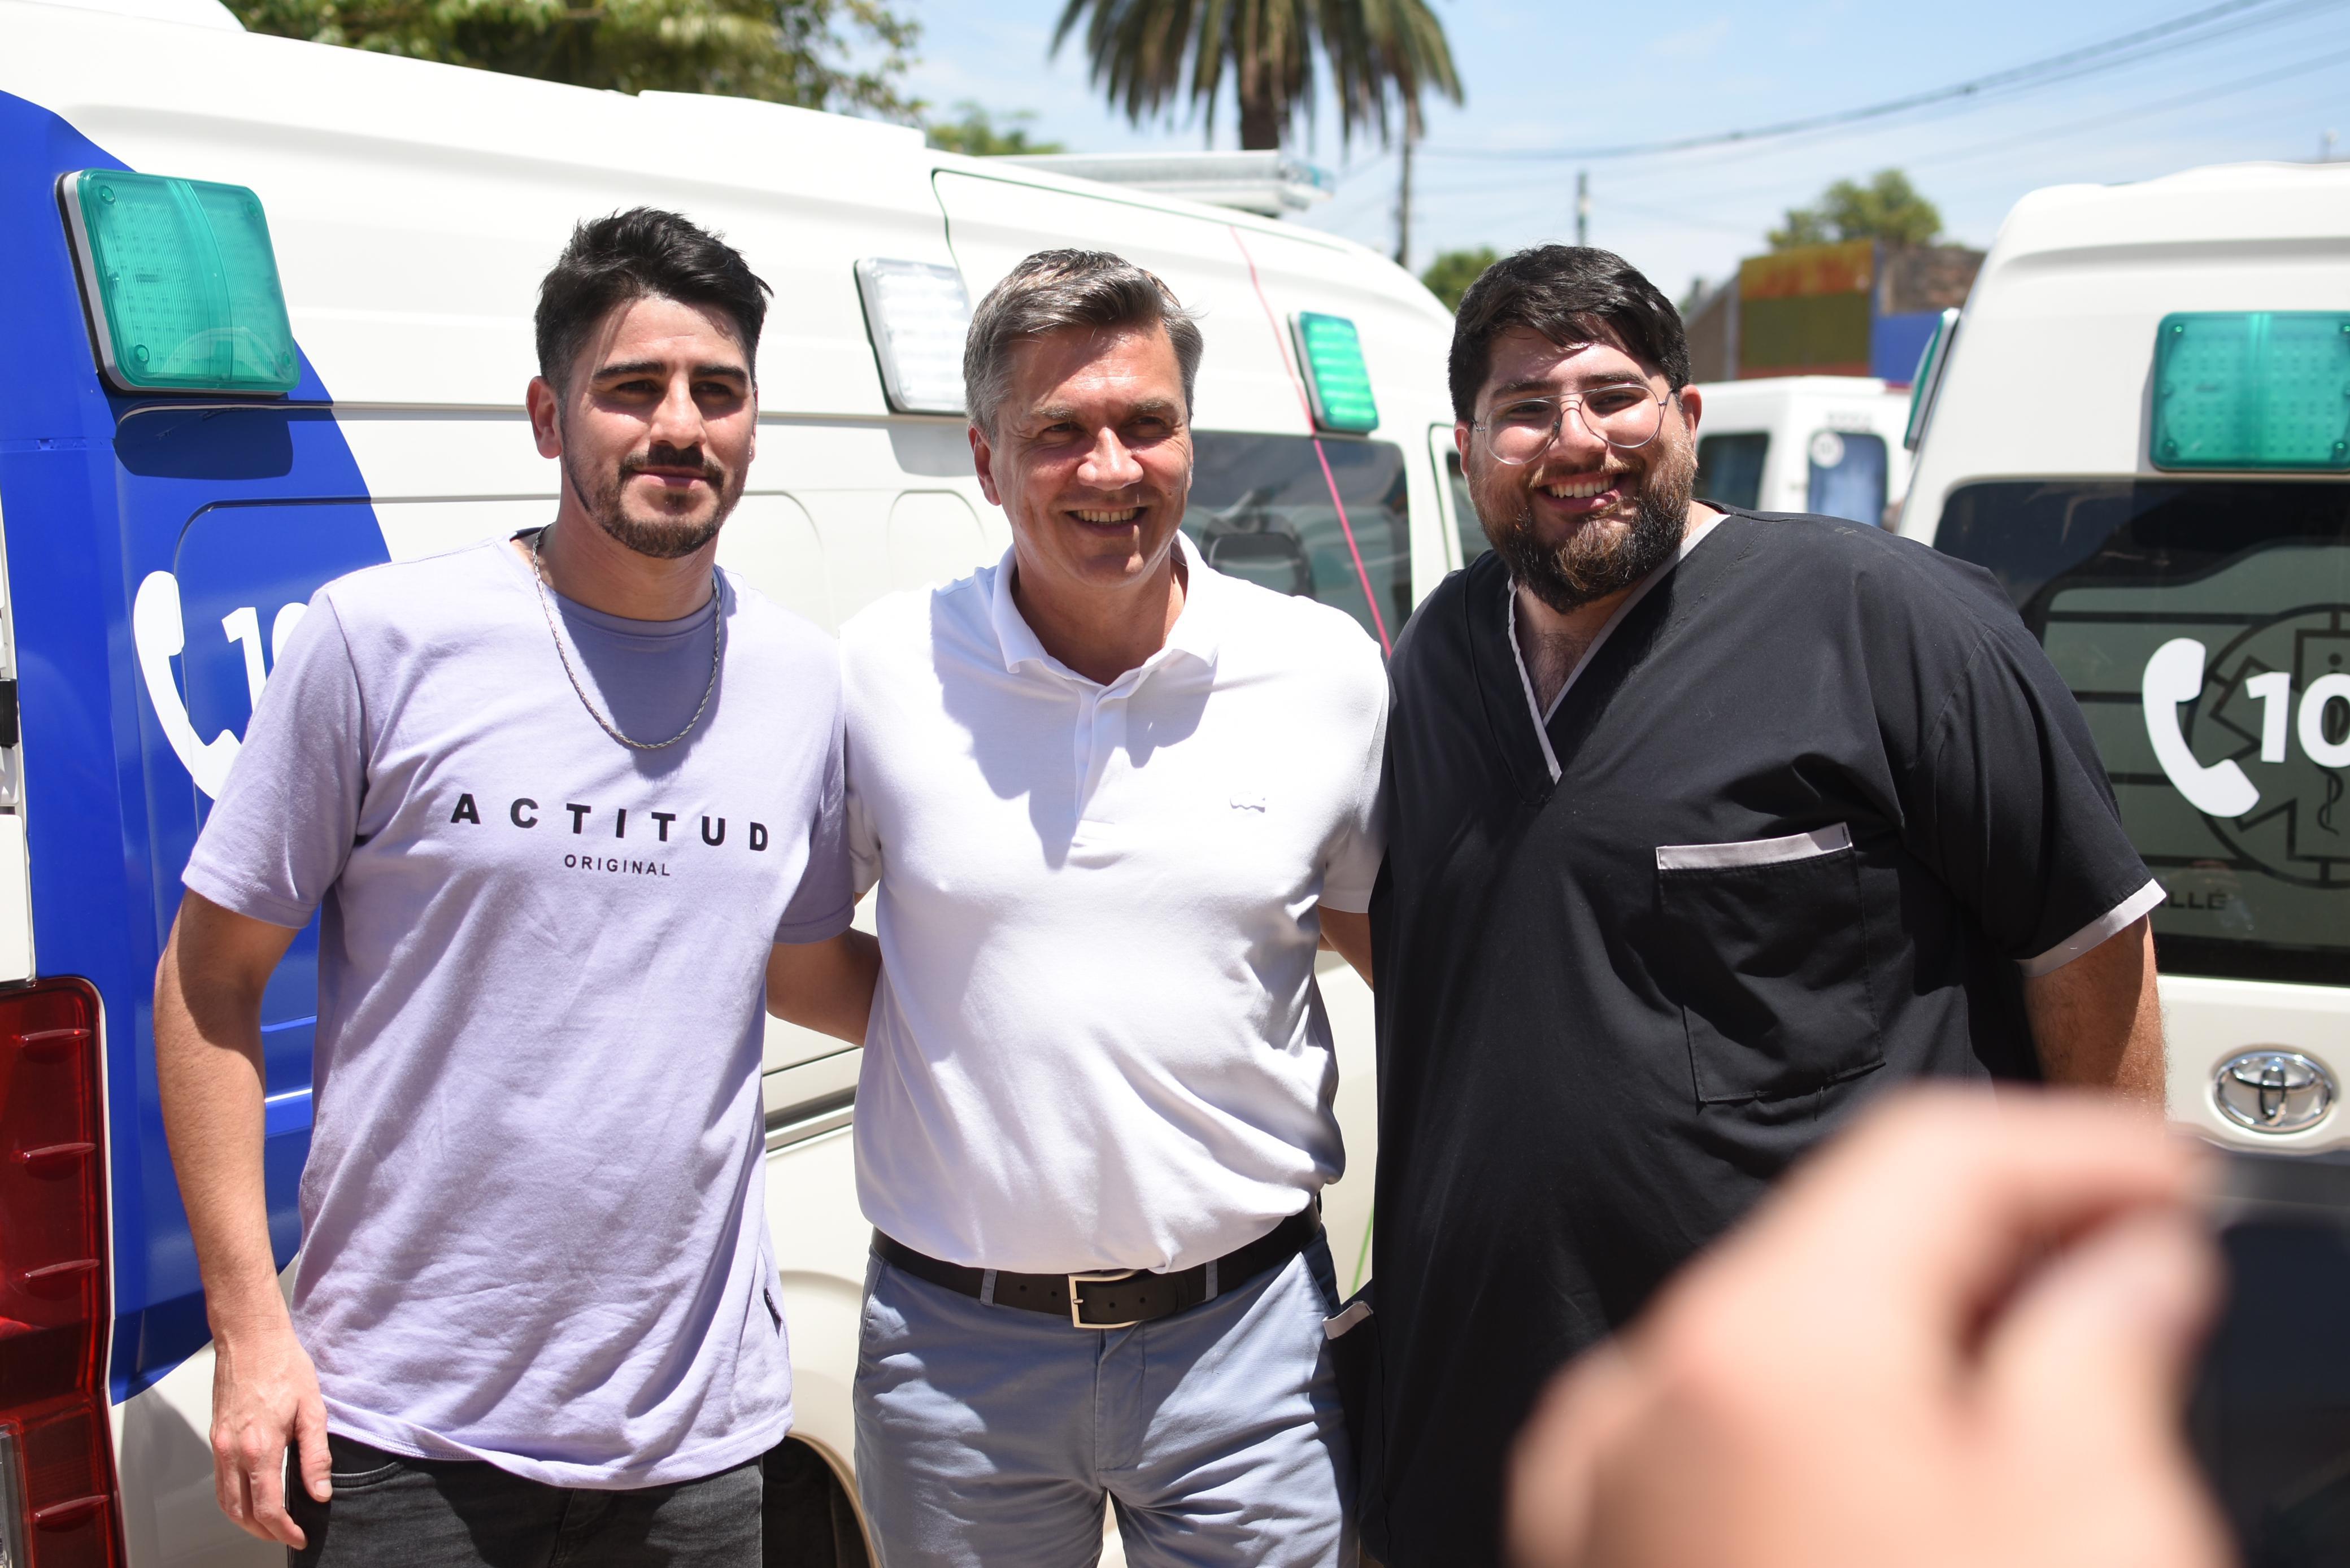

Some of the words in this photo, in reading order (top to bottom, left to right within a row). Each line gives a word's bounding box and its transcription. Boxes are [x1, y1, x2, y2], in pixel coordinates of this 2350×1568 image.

[2245, 671, 2350, 768] 10
[450, 793, 768, 851] ACTITUD
[564, 854, 670, 876] ORIGINAL
